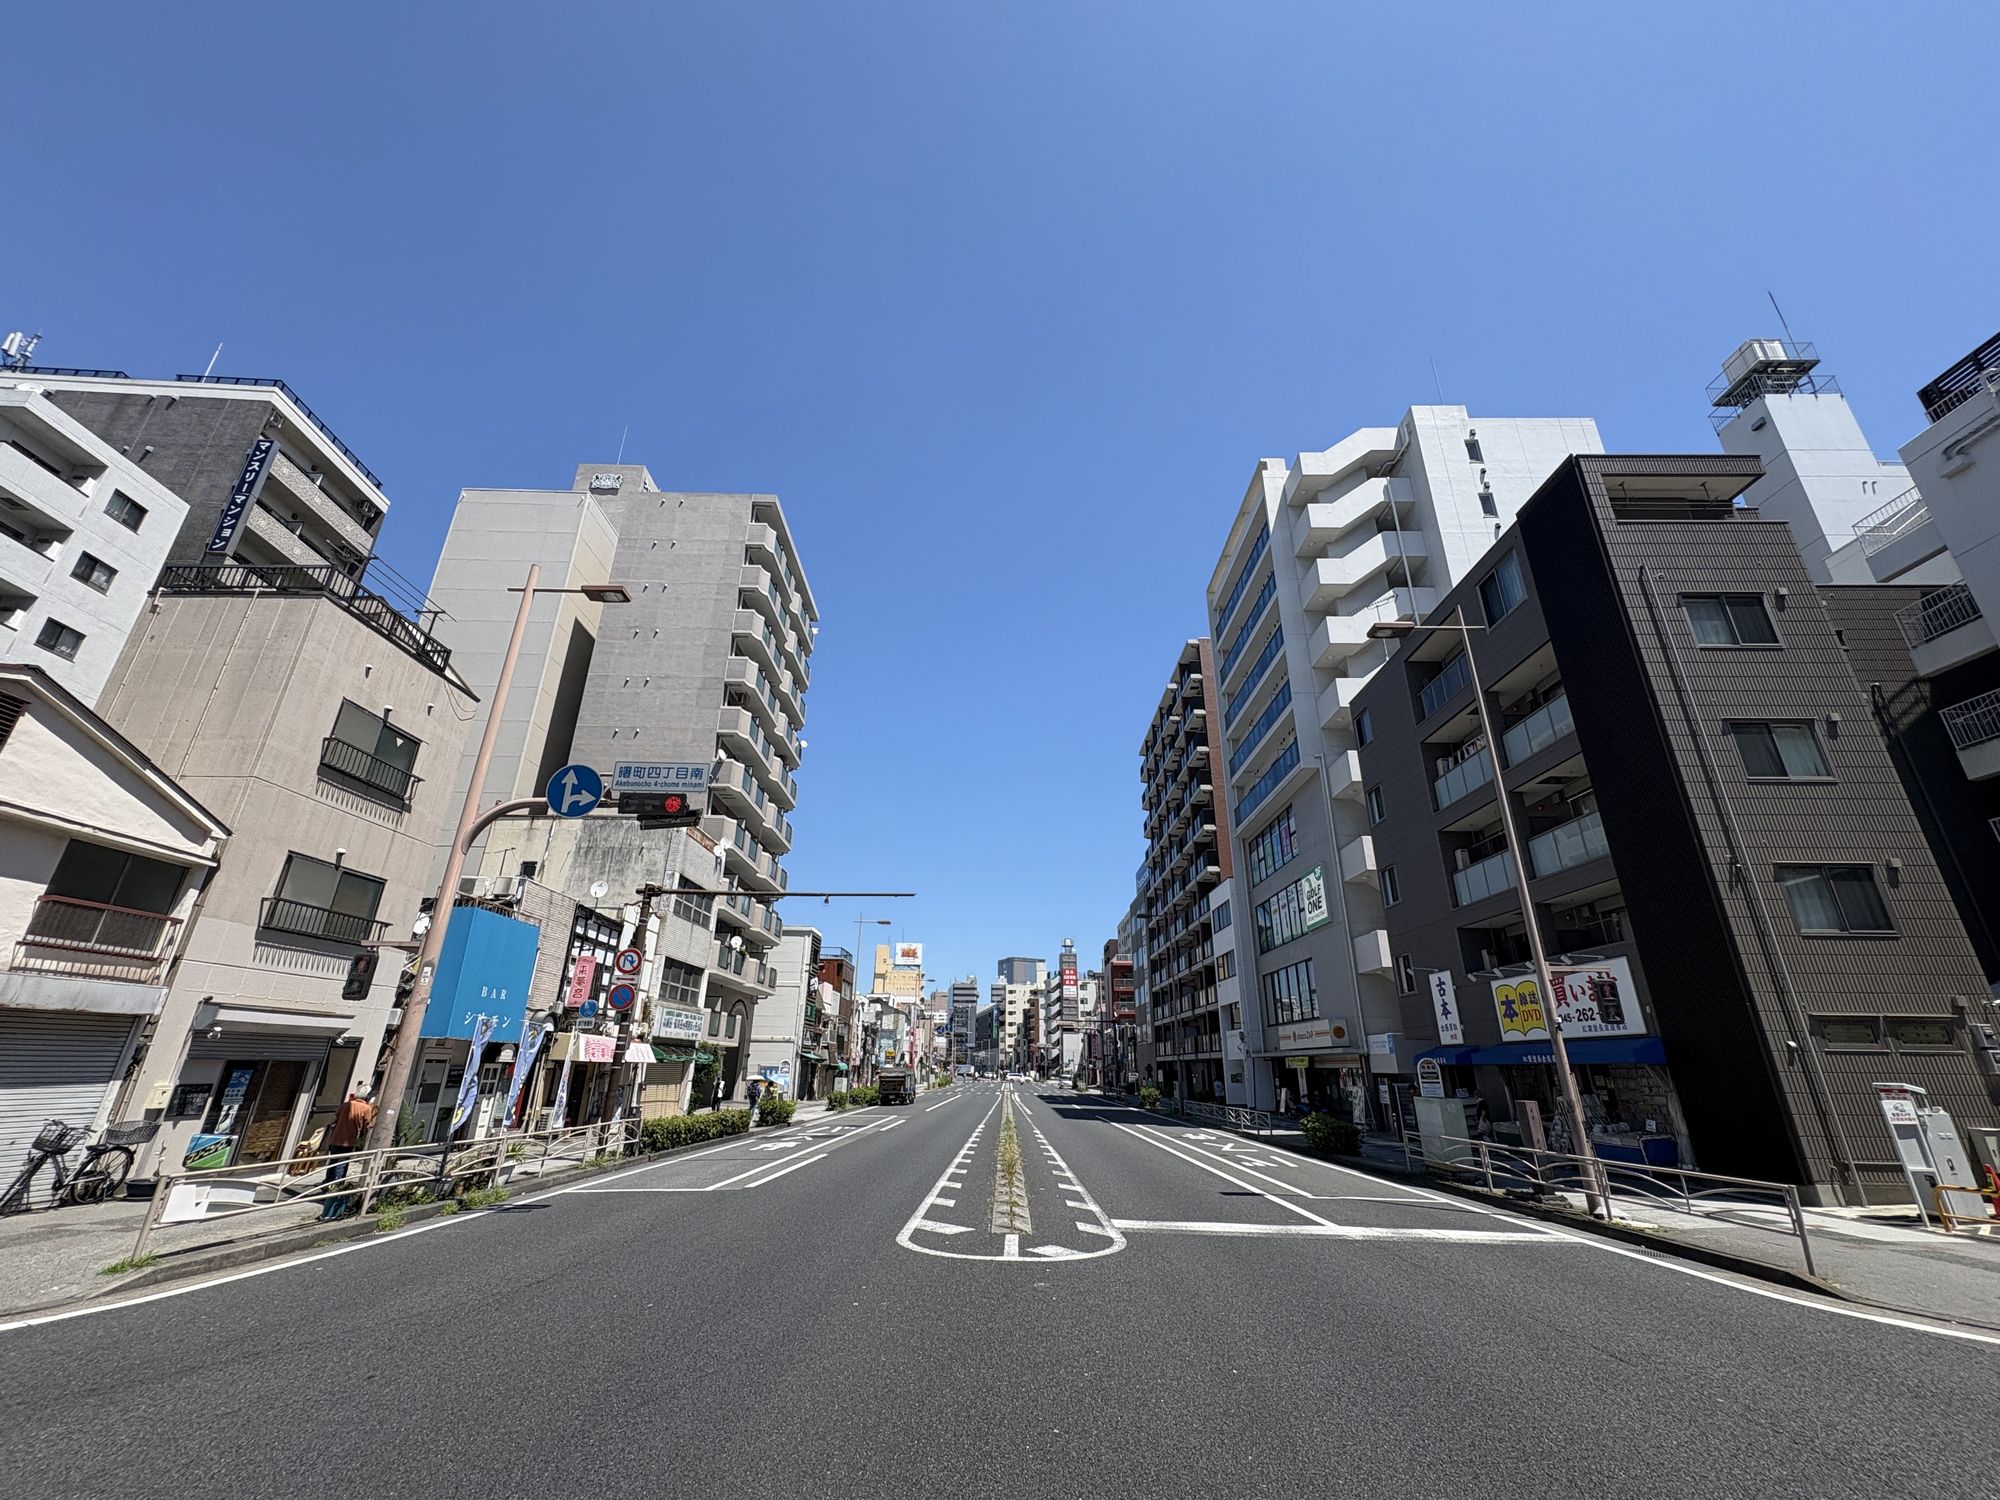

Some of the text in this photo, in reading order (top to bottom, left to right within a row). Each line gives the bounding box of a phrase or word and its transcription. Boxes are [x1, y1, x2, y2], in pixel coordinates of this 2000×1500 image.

[212, 441, 271, 549] マンスリーマンション
[618, 766, 704, 781] 曙町四丁目南
[614, 780, 705, 789] Akebonocho 4-chome minami
[1306, 884, 1321, 901] GOLF
[1307, 896, 1322, 914] ONE
[481, 986, 507, 1000] BAR
[1435, 975, 1452, 1021] 古本
[1518, 990, 1539, 1007] 雑誌
[1548, 972, 1618, 1009] 買いま
[1500, 995, 1519, 1023] 本
[1522, 1008, 1542, 1022] DVD
